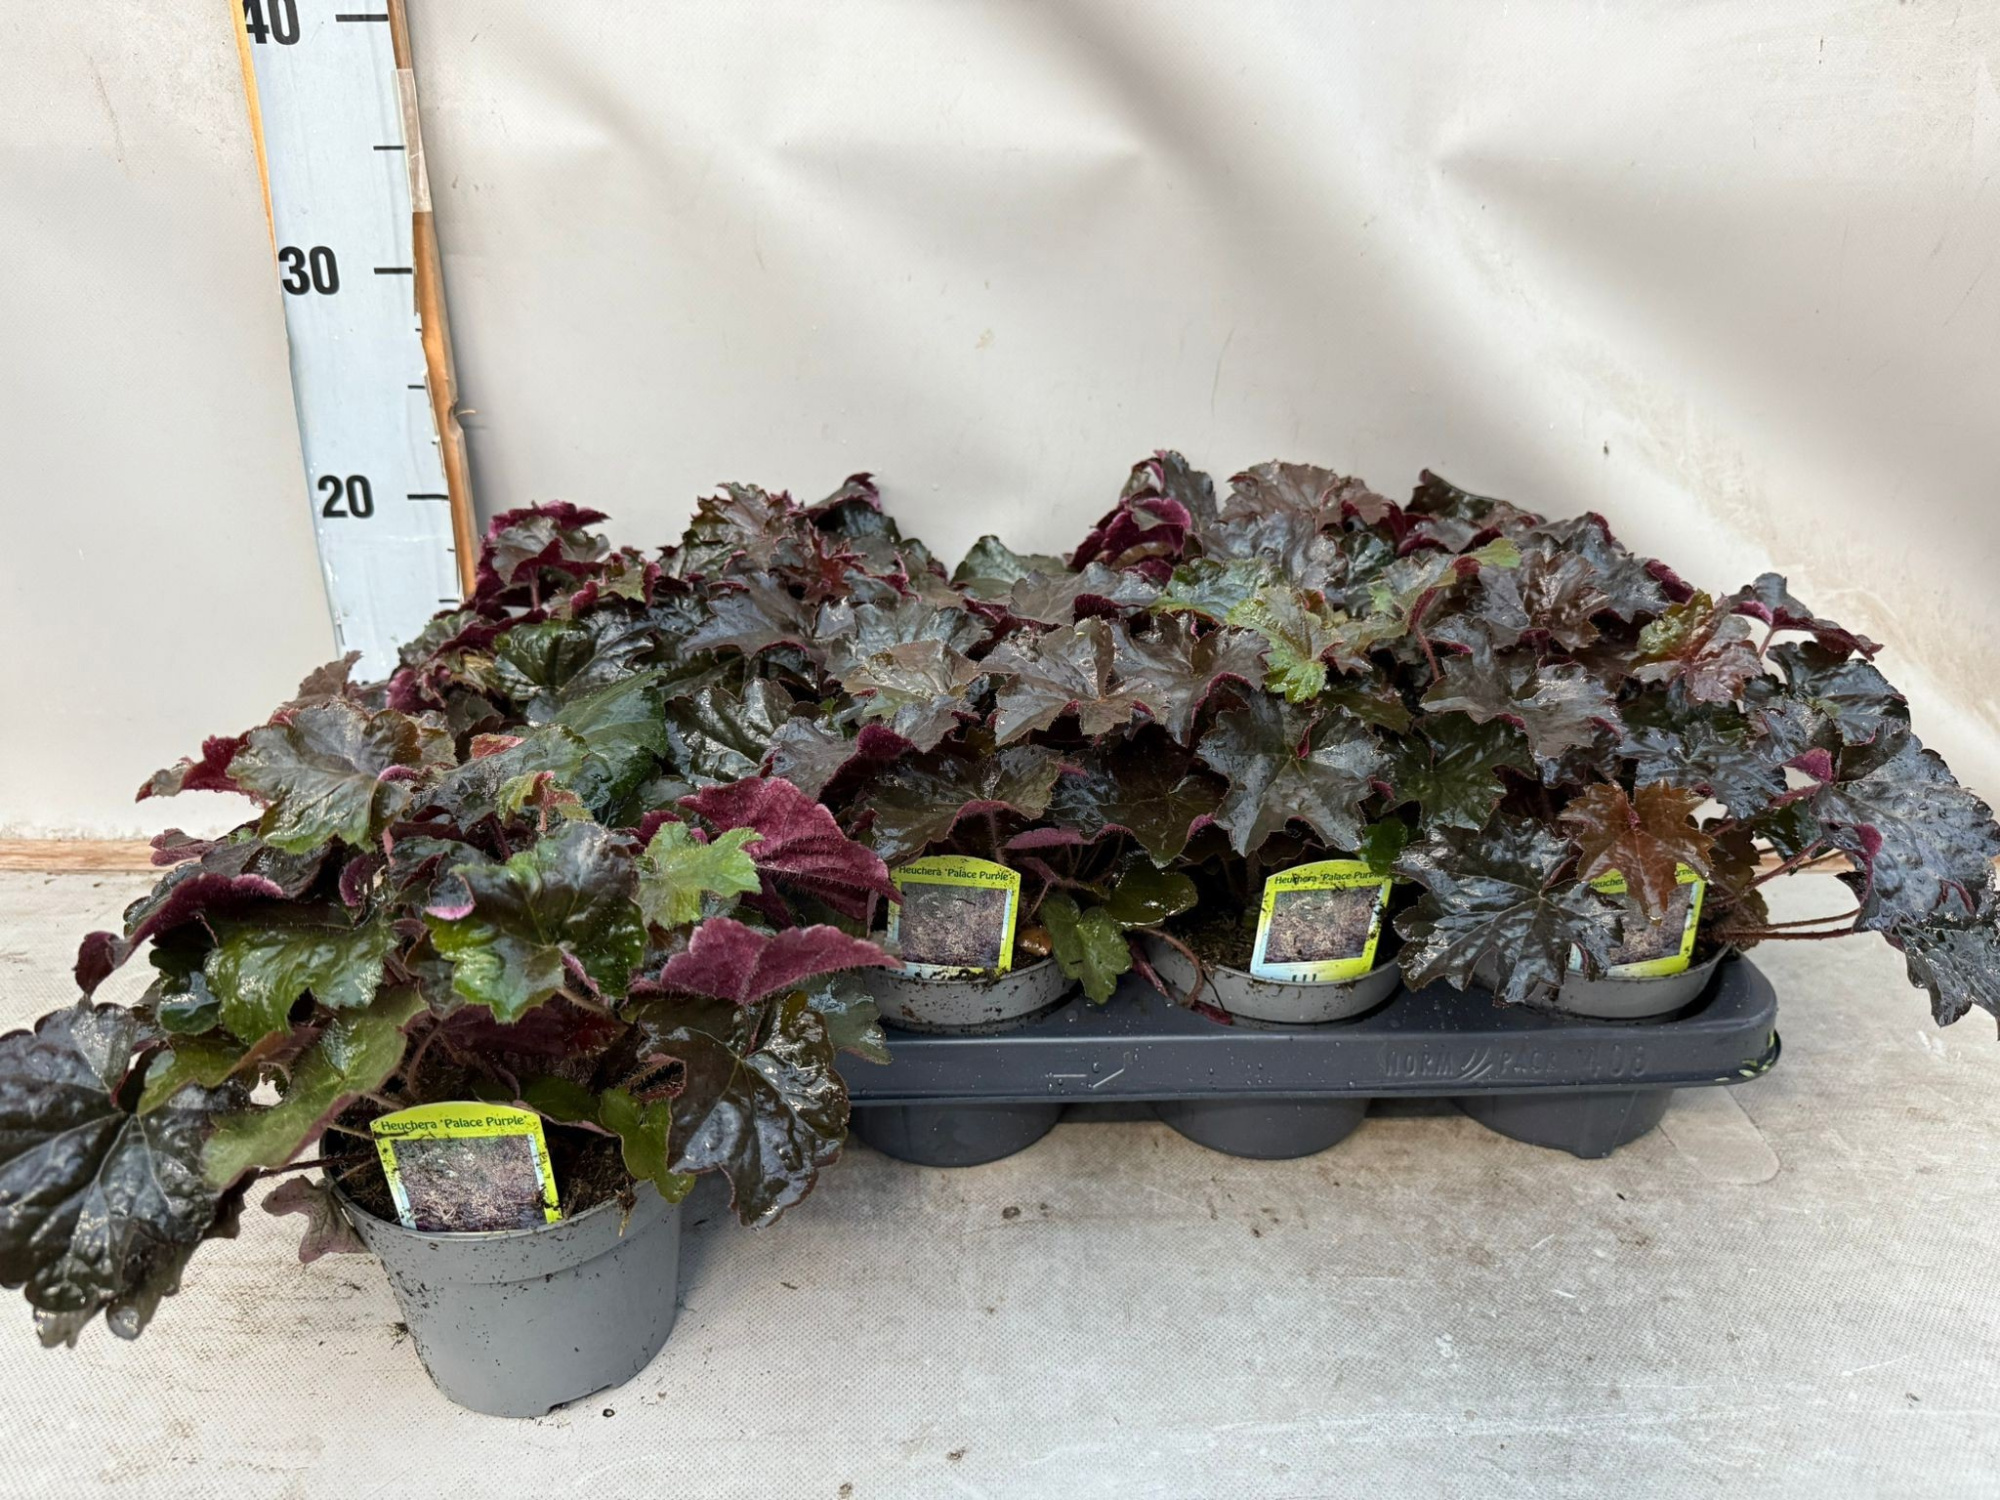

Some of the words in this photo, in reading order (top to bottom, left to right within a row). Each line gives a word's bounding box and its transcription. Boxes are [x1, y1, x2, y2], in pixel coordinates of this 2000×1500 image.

[242, 0, 300, 45] 40
[279, 246, 340, 295] 30
[317, 475, 375, 519] 20
[899, 866, 942, 876] Heuchera
[381, 1120, 438, 1131] Heuchera
